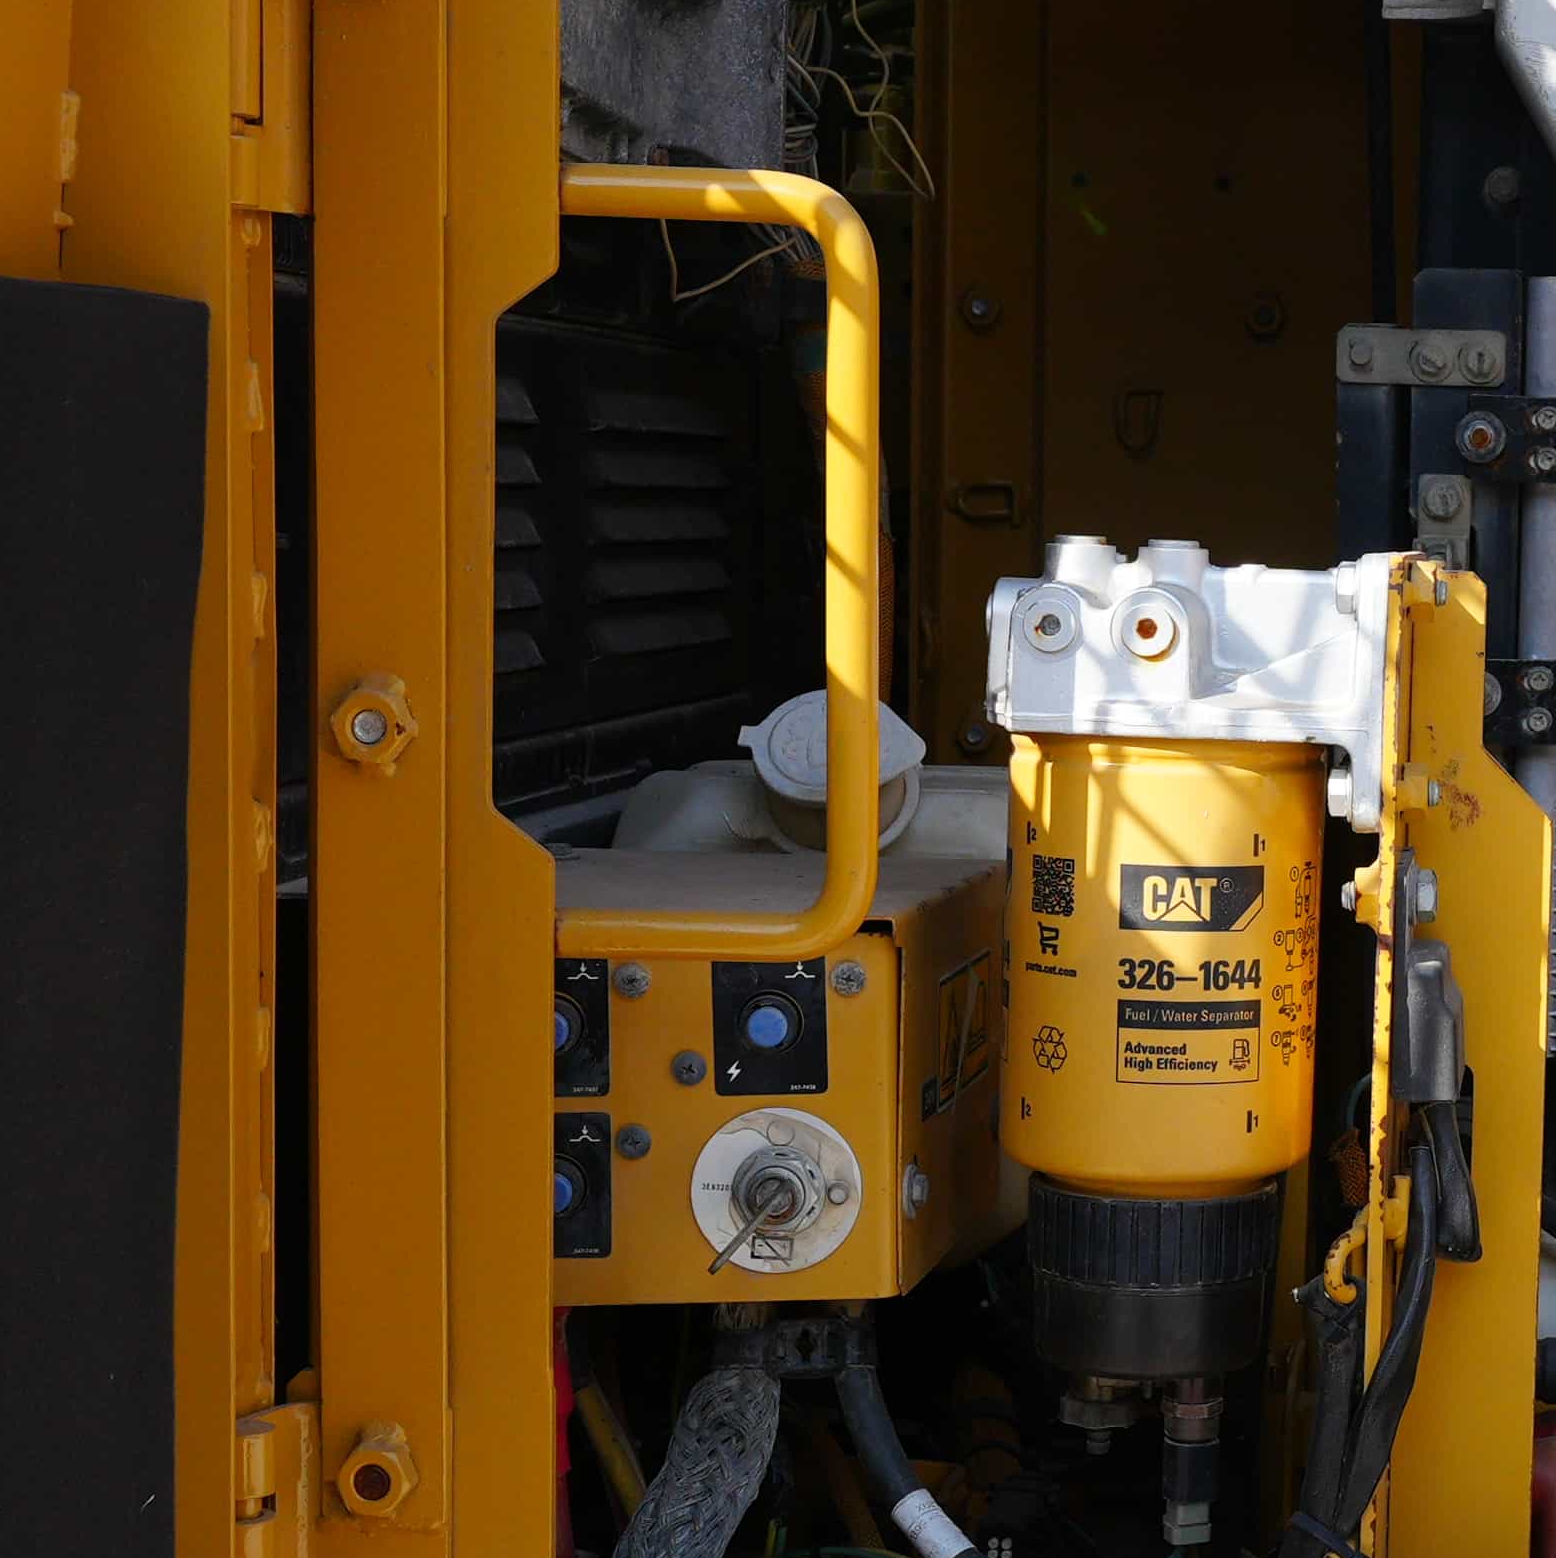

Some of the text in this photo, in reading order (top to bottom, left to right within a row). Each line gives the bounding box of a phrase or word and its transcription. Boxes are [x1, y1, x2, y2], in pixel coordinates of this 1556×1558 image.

[1143, 875, 1218, 923] CAT
[1117, 957, 1262, 992] 326-1644
[1125, 1006, 1149, 1022] Fuel
[1161, 1009, 1197, 1023] Water
[1200, 1008, 1255, 1024] Separator
[1124, 1041, 1187, 1056] Advanced
[1124, 1056, 1218, 1073] High Efficiency
